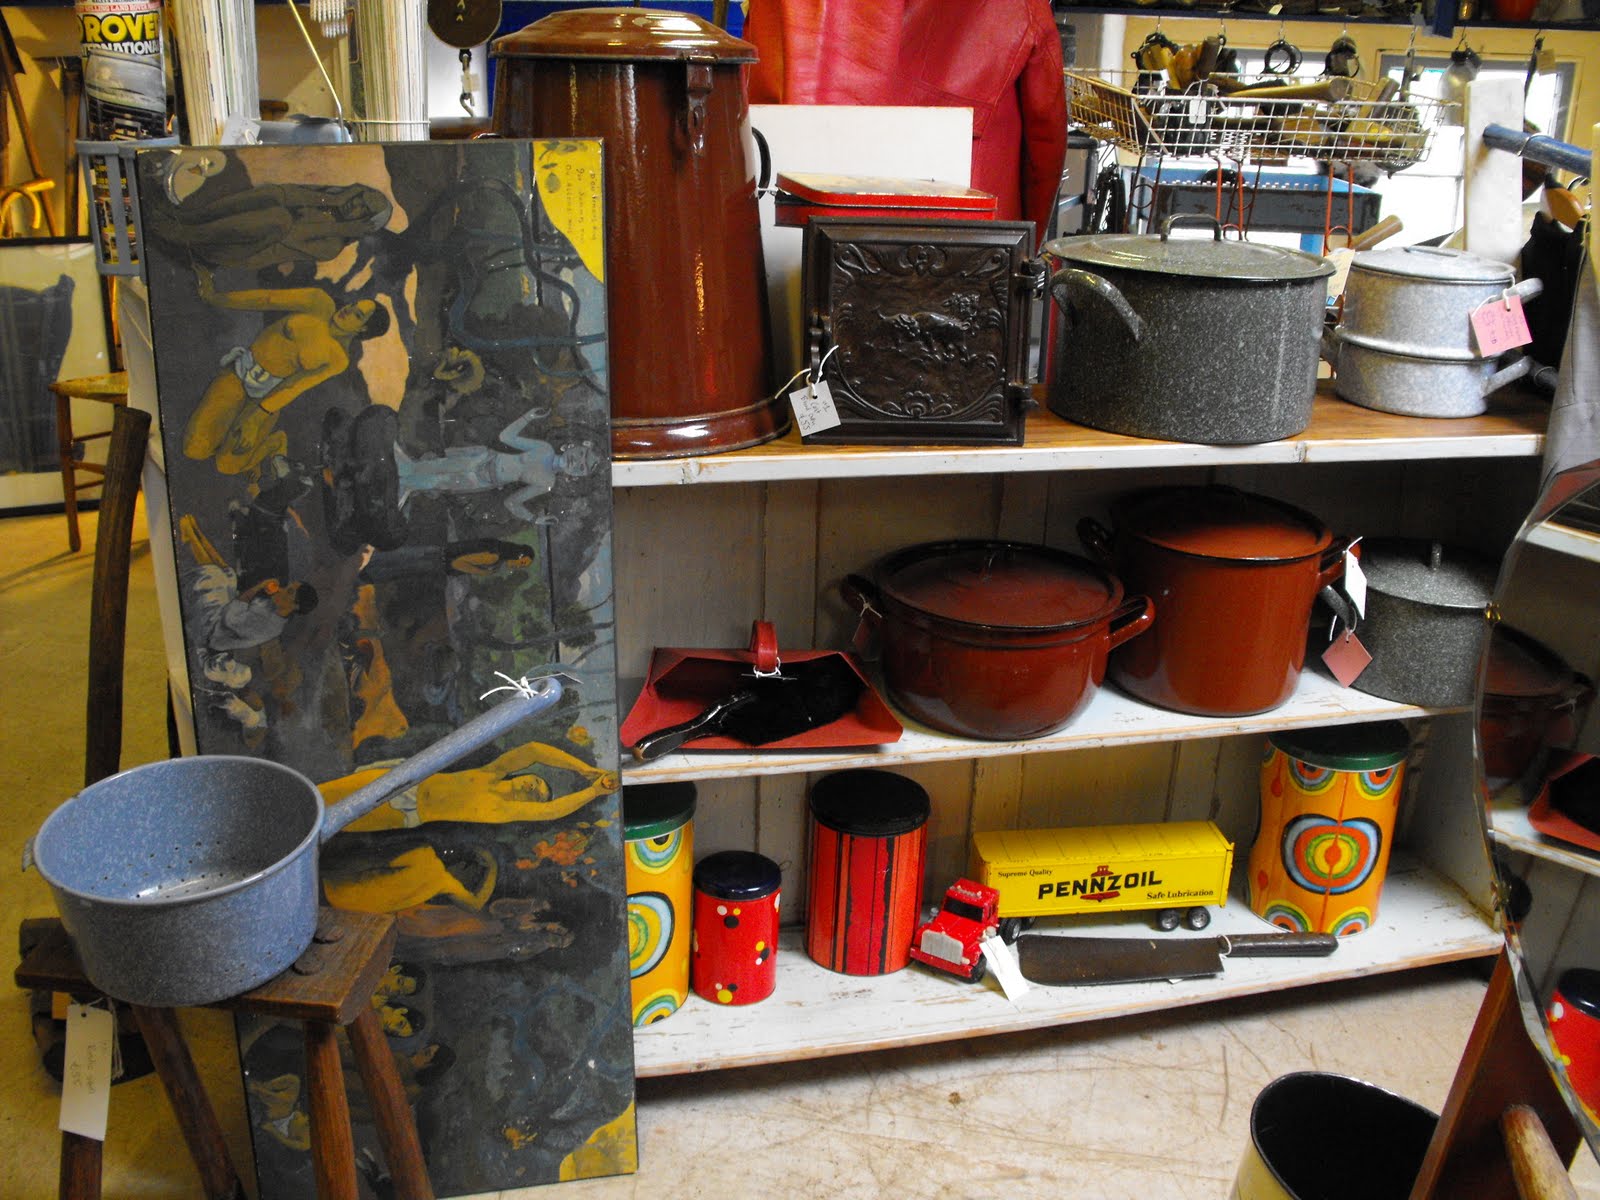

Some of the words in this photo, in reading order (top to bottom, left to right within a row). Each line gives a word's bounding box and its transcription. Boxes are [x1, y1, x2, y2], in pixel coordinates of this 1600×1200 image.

[1038, 871, 1162, 899] PENNZOIL
[1147, 892, 1165, 900] Safe
[1167, 889, 1214, 899] Lubrication
